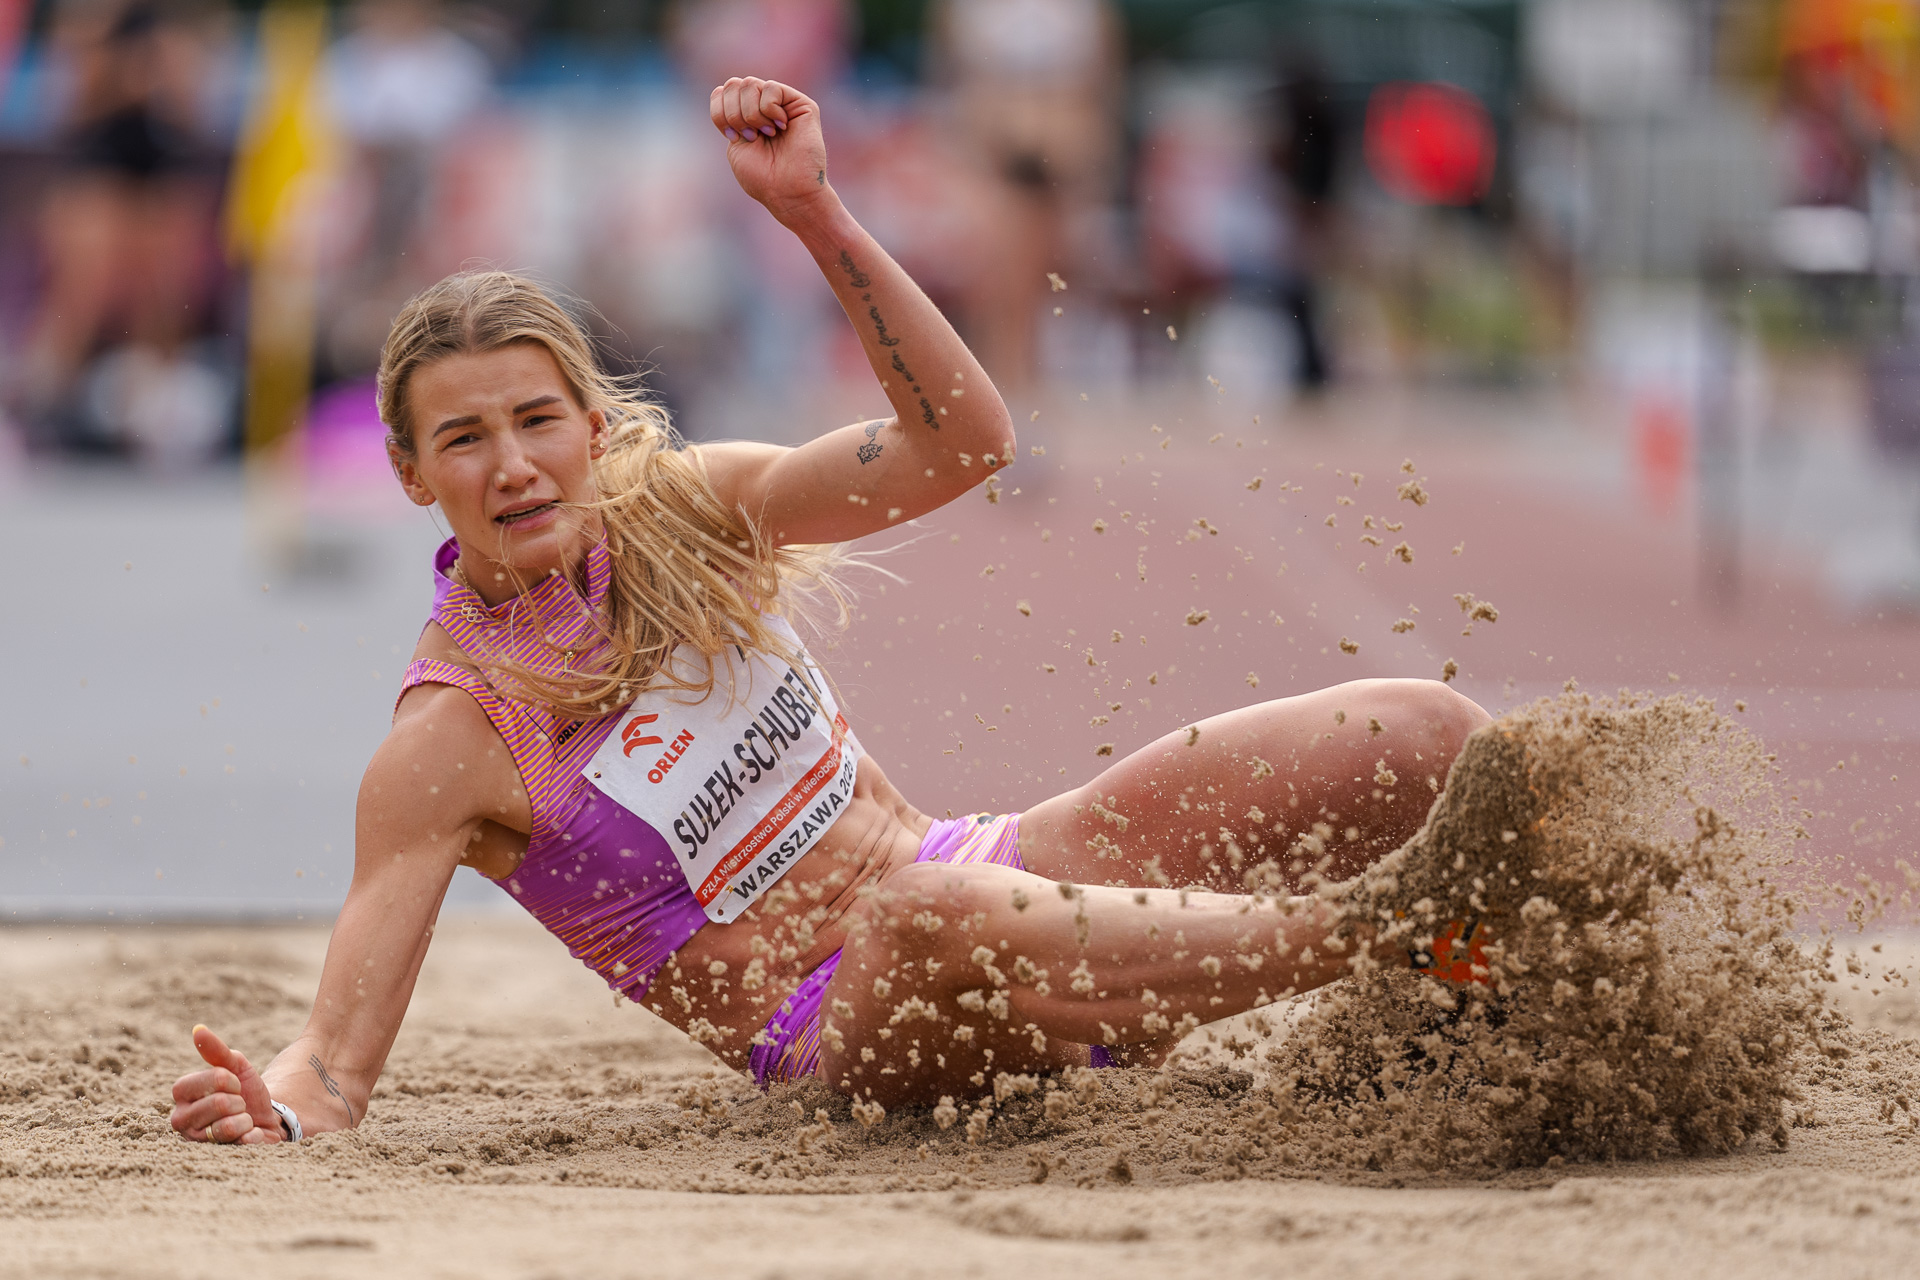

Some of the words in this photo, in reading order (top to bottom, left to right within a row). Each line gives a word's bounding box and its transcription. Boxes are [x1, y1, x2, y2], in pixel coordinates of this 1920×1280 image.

[557, 720, 586, 745] ORLE
[647, 728, 695, 784] ORLEN
[702, 875, 721, 898] PZLA
[719, 824, 773, 876] Mistrzostwa
[770, 798, 796, 827] Polski
[793, 791, 803, 803] w
[733, 792, 844, 899] WARSZAWA
